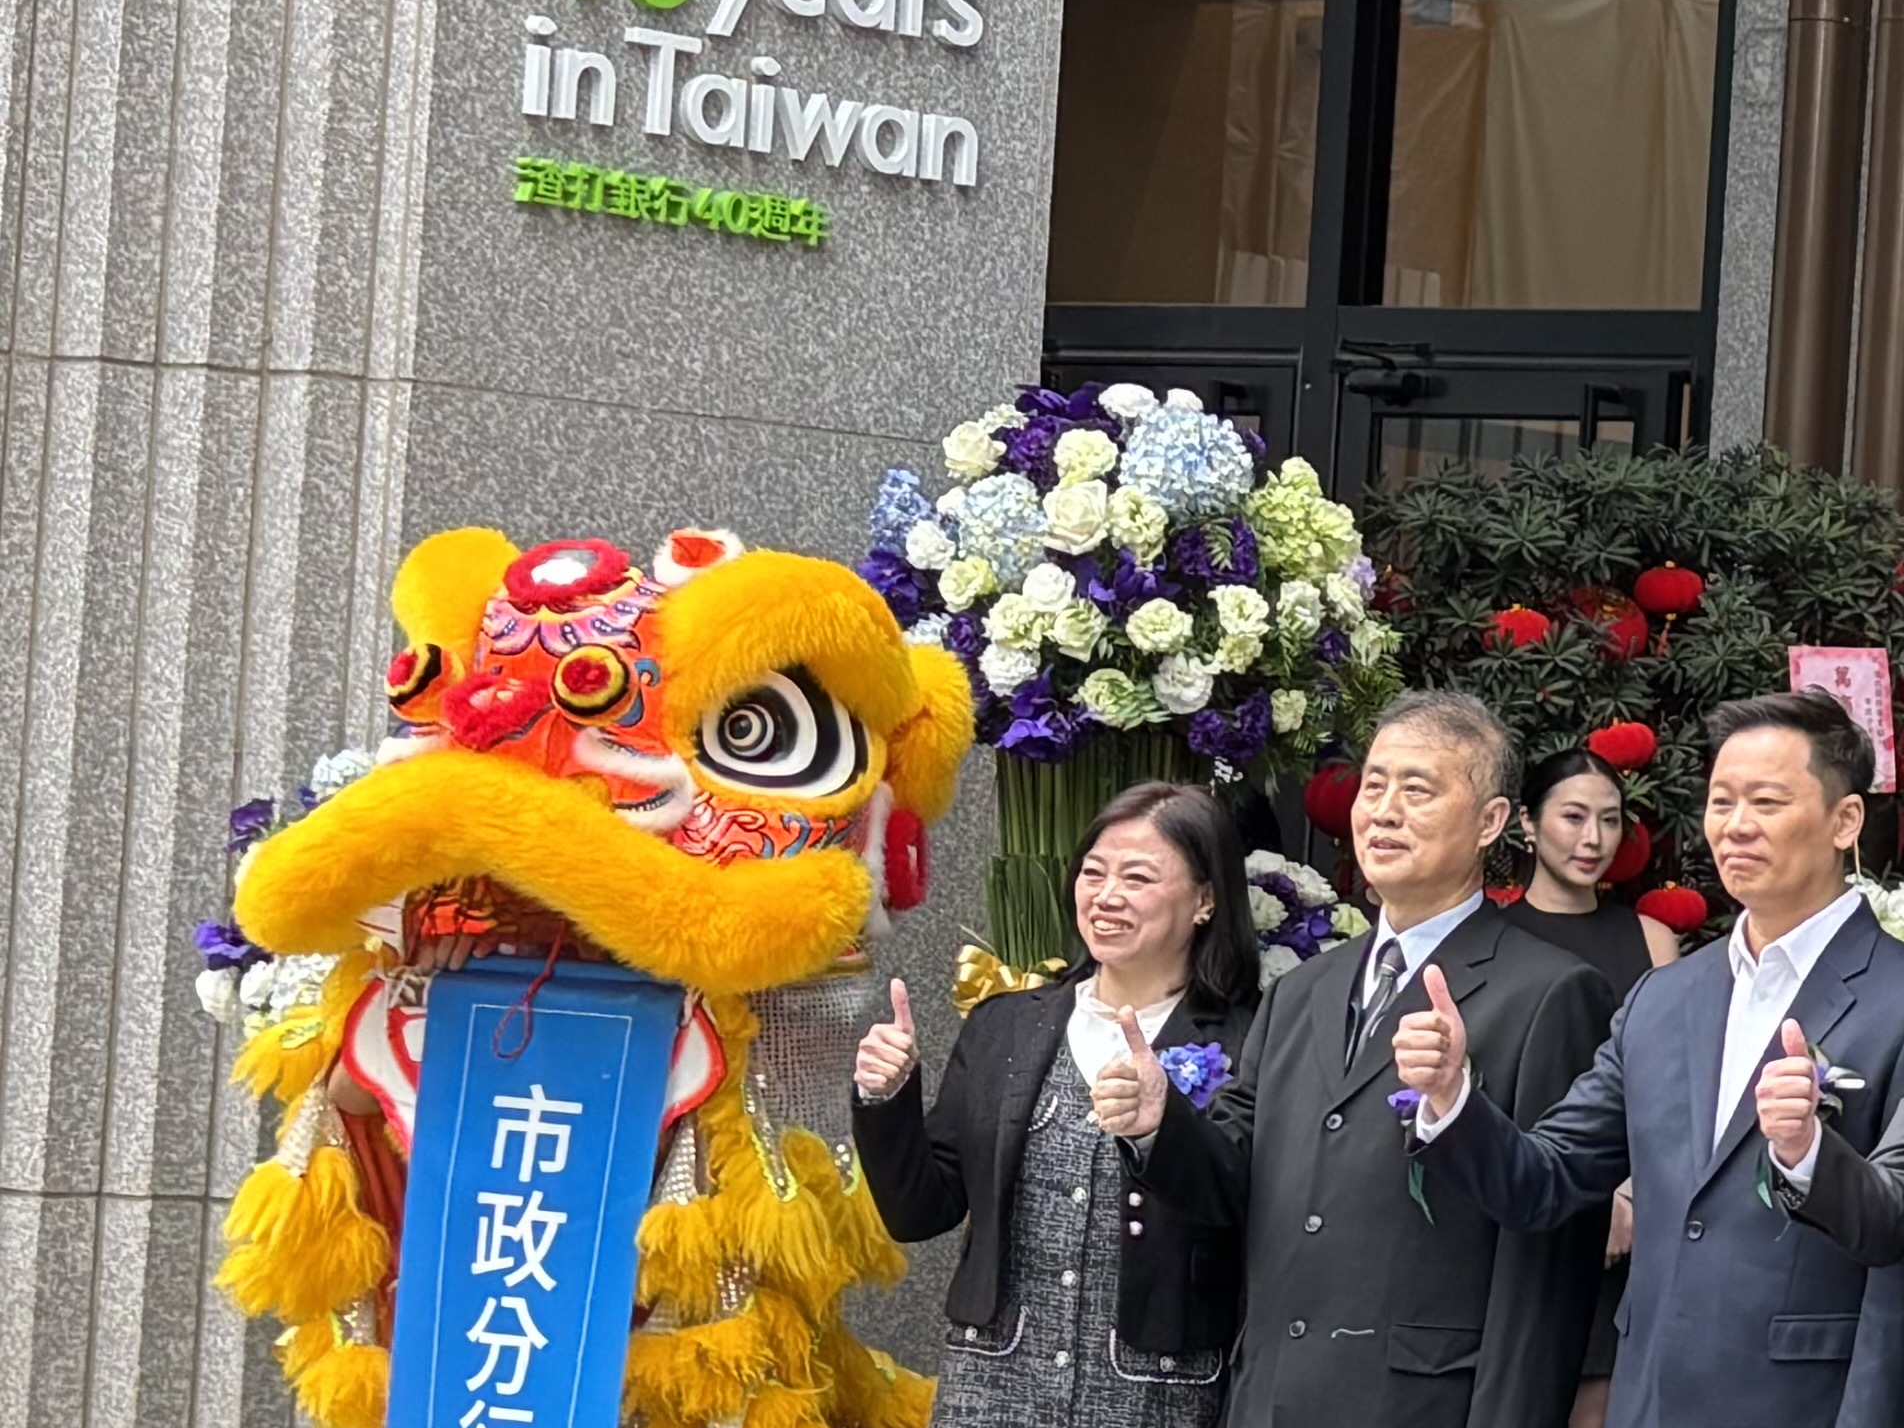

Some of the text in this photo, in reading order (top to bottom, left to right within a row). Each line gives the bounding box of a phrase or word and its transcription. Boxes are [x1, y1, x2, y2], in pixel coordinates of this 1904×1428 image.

[521, 14, 981, 188] in Taiwan
[512, 156, 831, 248] 渣打銀行40週年
